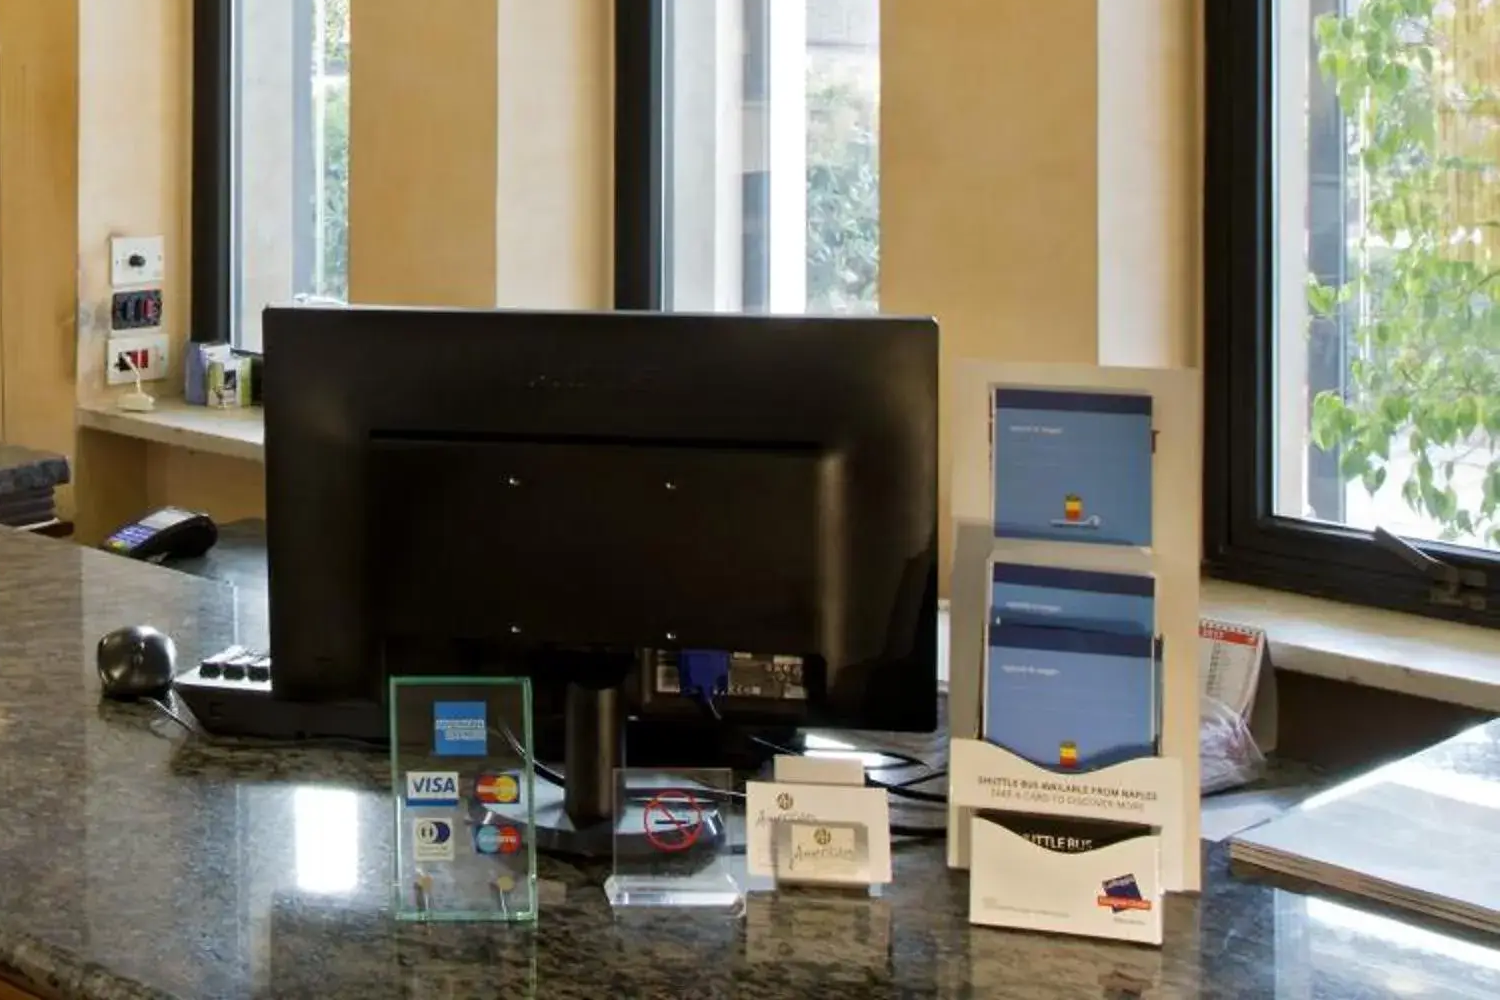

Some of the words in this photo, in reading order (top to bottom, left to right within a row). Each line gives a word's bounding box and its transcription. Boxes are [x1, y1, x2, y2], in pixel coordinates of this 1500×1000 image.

[413, 777, 456, 793] VISA
[978, 776, 1018, 789] SHUTTLE
[1021, 779, 1039, 790] BUS
[1041, 781, 1088, 795] AVAILABLE
[1091, 785, 1121, 798] FROM
[1122, 789, 1158, 801] NAPLES
[1067, 837, 1093, 851] BUS
